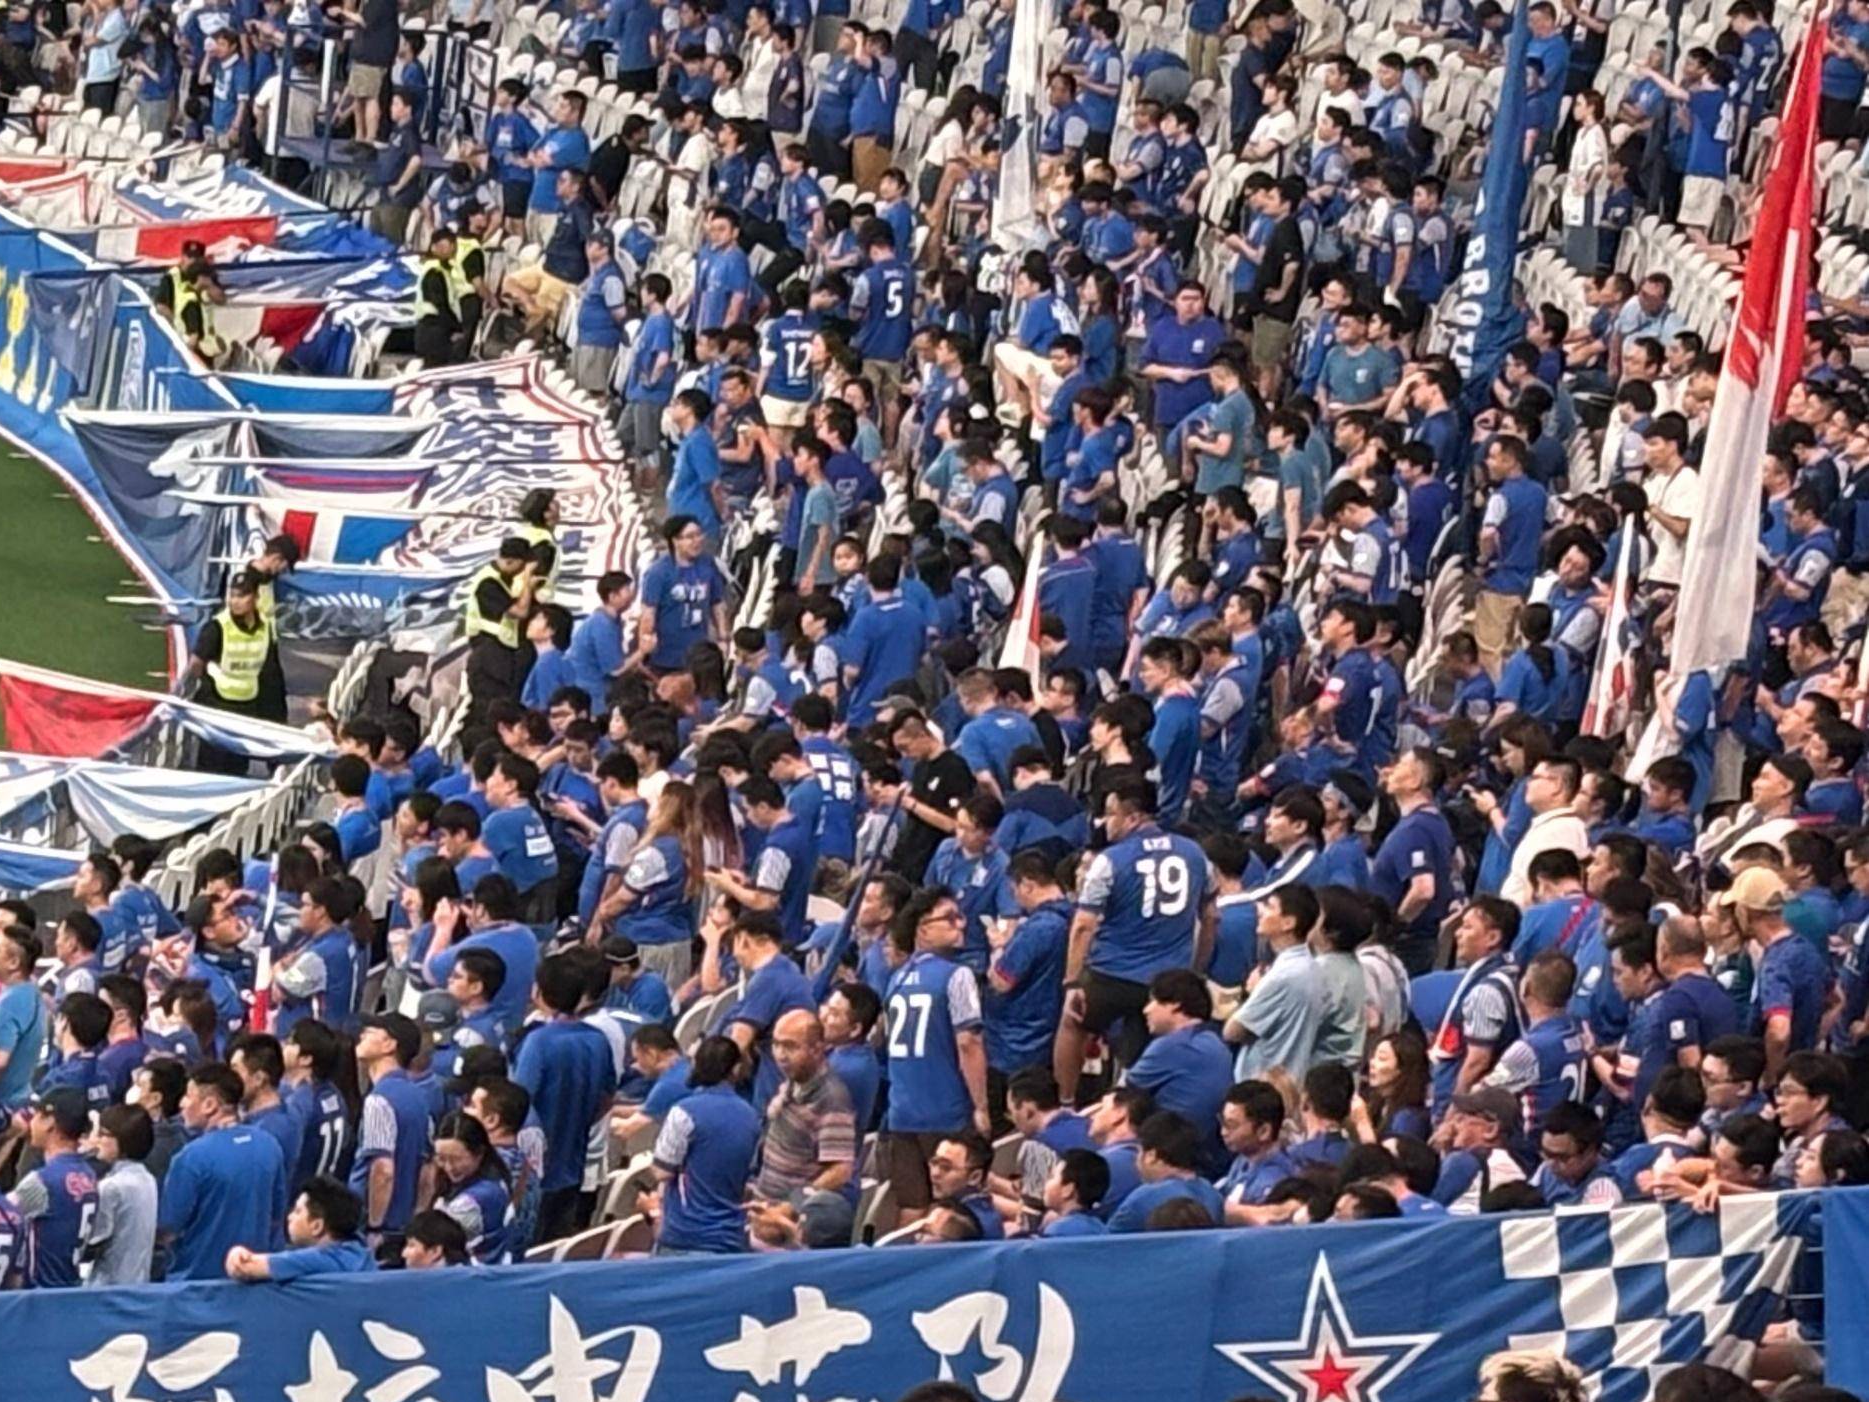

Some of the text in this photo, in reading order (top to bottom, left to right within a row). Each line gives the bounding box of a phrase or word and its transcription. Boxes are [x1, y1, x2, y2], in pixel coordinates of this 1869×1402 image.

[885, 280, 904, 318] 5
[784, 341, 812, 379] 12
[1135, 855, 1188, 918] 19
[888, 992, 932, 1058] 27
